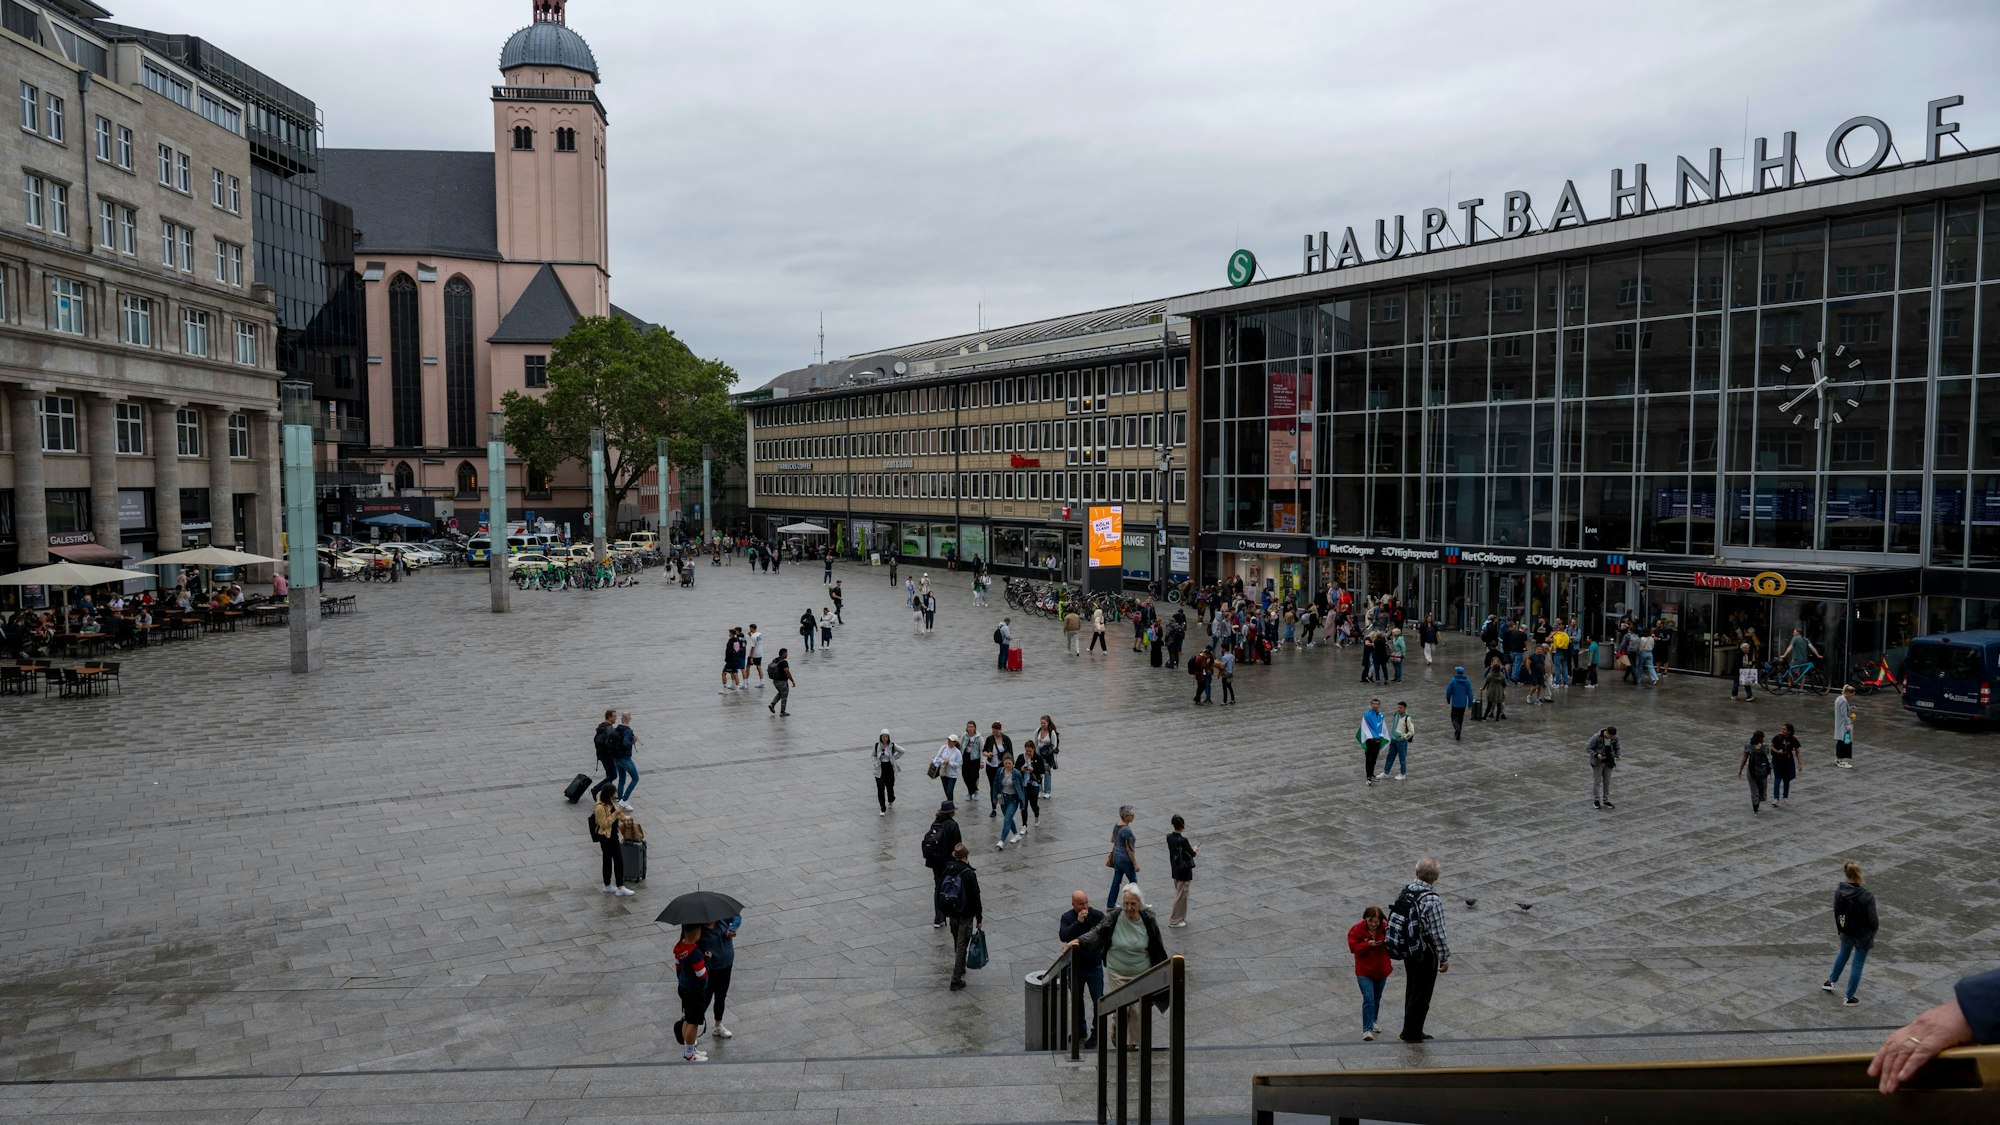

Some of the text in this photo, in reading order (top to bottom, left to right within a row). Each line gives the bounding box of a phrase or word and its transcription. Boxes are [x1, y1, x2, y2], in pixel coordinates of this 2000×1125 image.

[1303, 95, 1964, 275] HAUPTBAHNHOF
[1231, 254, 1248, 282] S
[50, 534, 89, 545] GALESTRO
[1330, 544, 1440, 560] NetCologne Highspeed
[1461, 552, 1597, 569] NetCologne Highspeed
[1627, 560, 1647, 572] Net
[1694, 571, 1752, 591] Kamps
